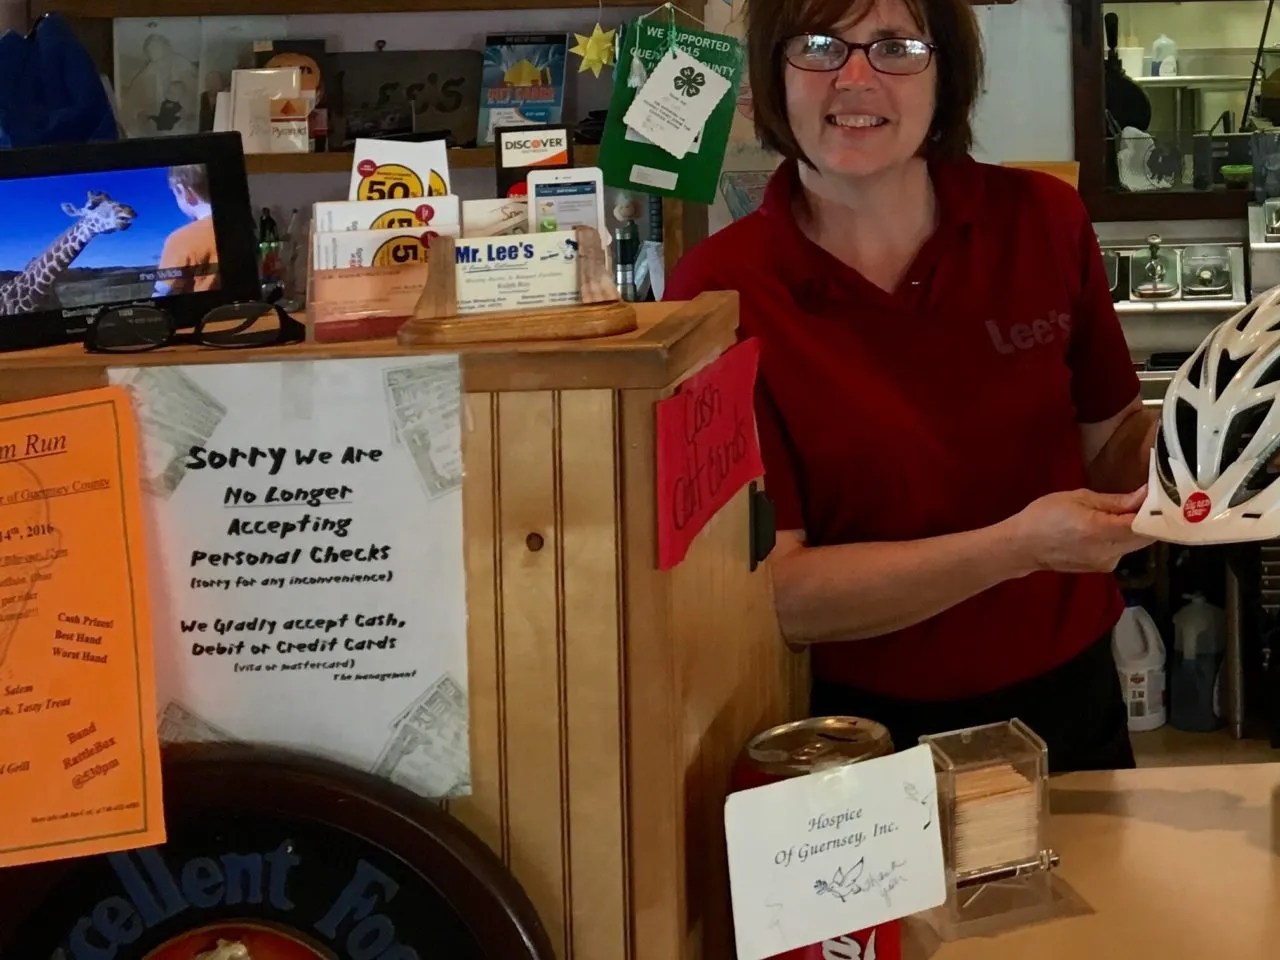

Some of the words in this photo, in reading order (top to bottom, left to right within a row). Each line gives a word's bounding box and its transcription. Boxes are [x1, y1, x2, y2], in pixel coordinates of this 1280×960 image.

[646, 26, 663, 38] WE
[505, 138, 563, 150] DISCOVER
[455, 246, 482, 264] Mr.
[487, 242, 534, 262] Lee's
[985, 309, 1071, 354] Lee's
[25, 432, 67, 456] Run
[185, 445, 286, 475] Sorry
[295, 449, 332, 465] We
[341, 446, 383, 464] Are
[72, 477, 110, 491] County
[224, 486, 257, 504] No
[264, 485, 353, 507] Longer
[27, 523, 55, 537] 2016
[227, 514, 353, 539] Accepting
[190, 548, 302, 567] Personal
[309, 544, 392, 563] Checks
[190, 577, 230, 590] (sorry
[235, 575, 257, 587] for
[261, 576, 285, 588] any
[289, 570, 394, 585] inconvenience)
[57, 612, 81, 625] Cash
[180, 620, 208, 633] We
[213, 617, 277, 635] Gladly
[282, 613, 349, 632] accept
[354, 612, 406, 628] Cash,
[55, 630, 74, 641] Best
[76, 630, 103, 645] Hand
[192, 640, 245, 656] Debit
[250, 644, 271, 655] or
[276, 637, 338, 653] Credit
[344, 636, 398, 652] Cards
[52, 646, 80, 660] Worst
[81, 649, 108, 664] Hand
[265, 663, 278, 672] or
[4, 684, 33, 696] Salem
[45, 697, 71, 709] Treat
[66, 722, 97, 744] Band
[62, 736, 117, 770] RattleBox
[6, 761, 30, 775] Grill
[808, 807, 863, 832] Hospice
[774, 845, 795, 867] Of
[798, 832, 867, 862] Guernsey,
[873, 822, 899, 837] Inc.
